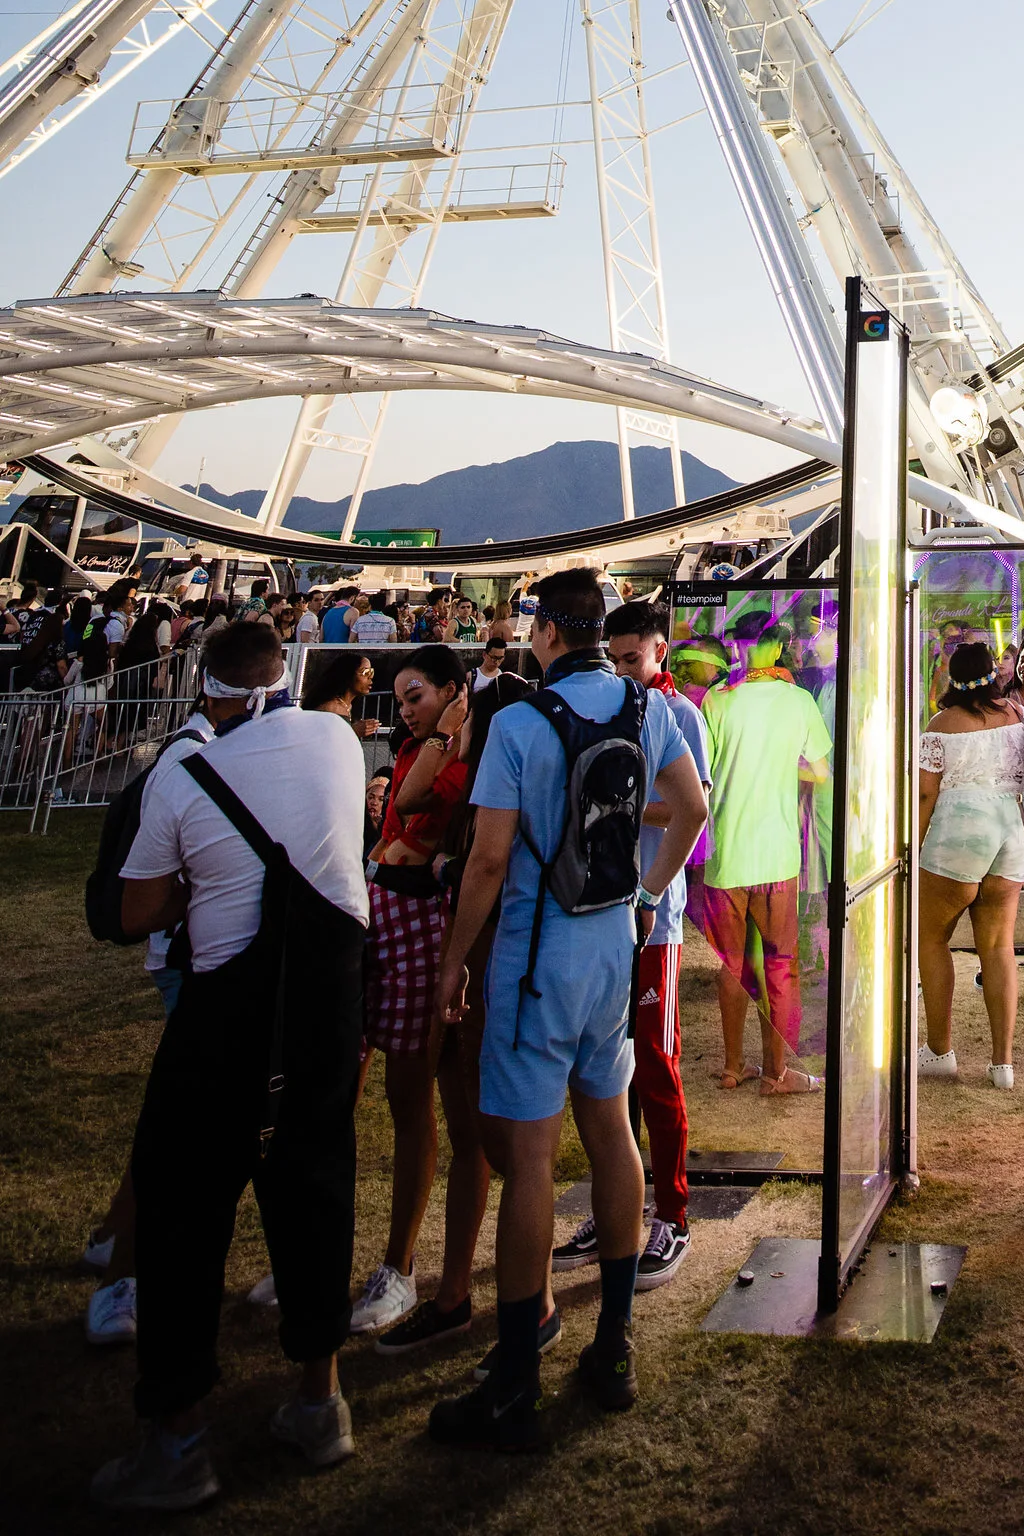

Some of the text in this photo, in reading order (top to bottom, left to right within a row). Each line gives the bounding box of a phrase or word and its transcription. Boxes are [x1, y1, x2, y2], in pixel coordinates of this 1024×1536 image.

[863, 315, 885, 337] G
[677, 593, 723, 605] #teampixel
[932, 603, 974, 622] Grande
[639, 996, 661, 1006] adidas
